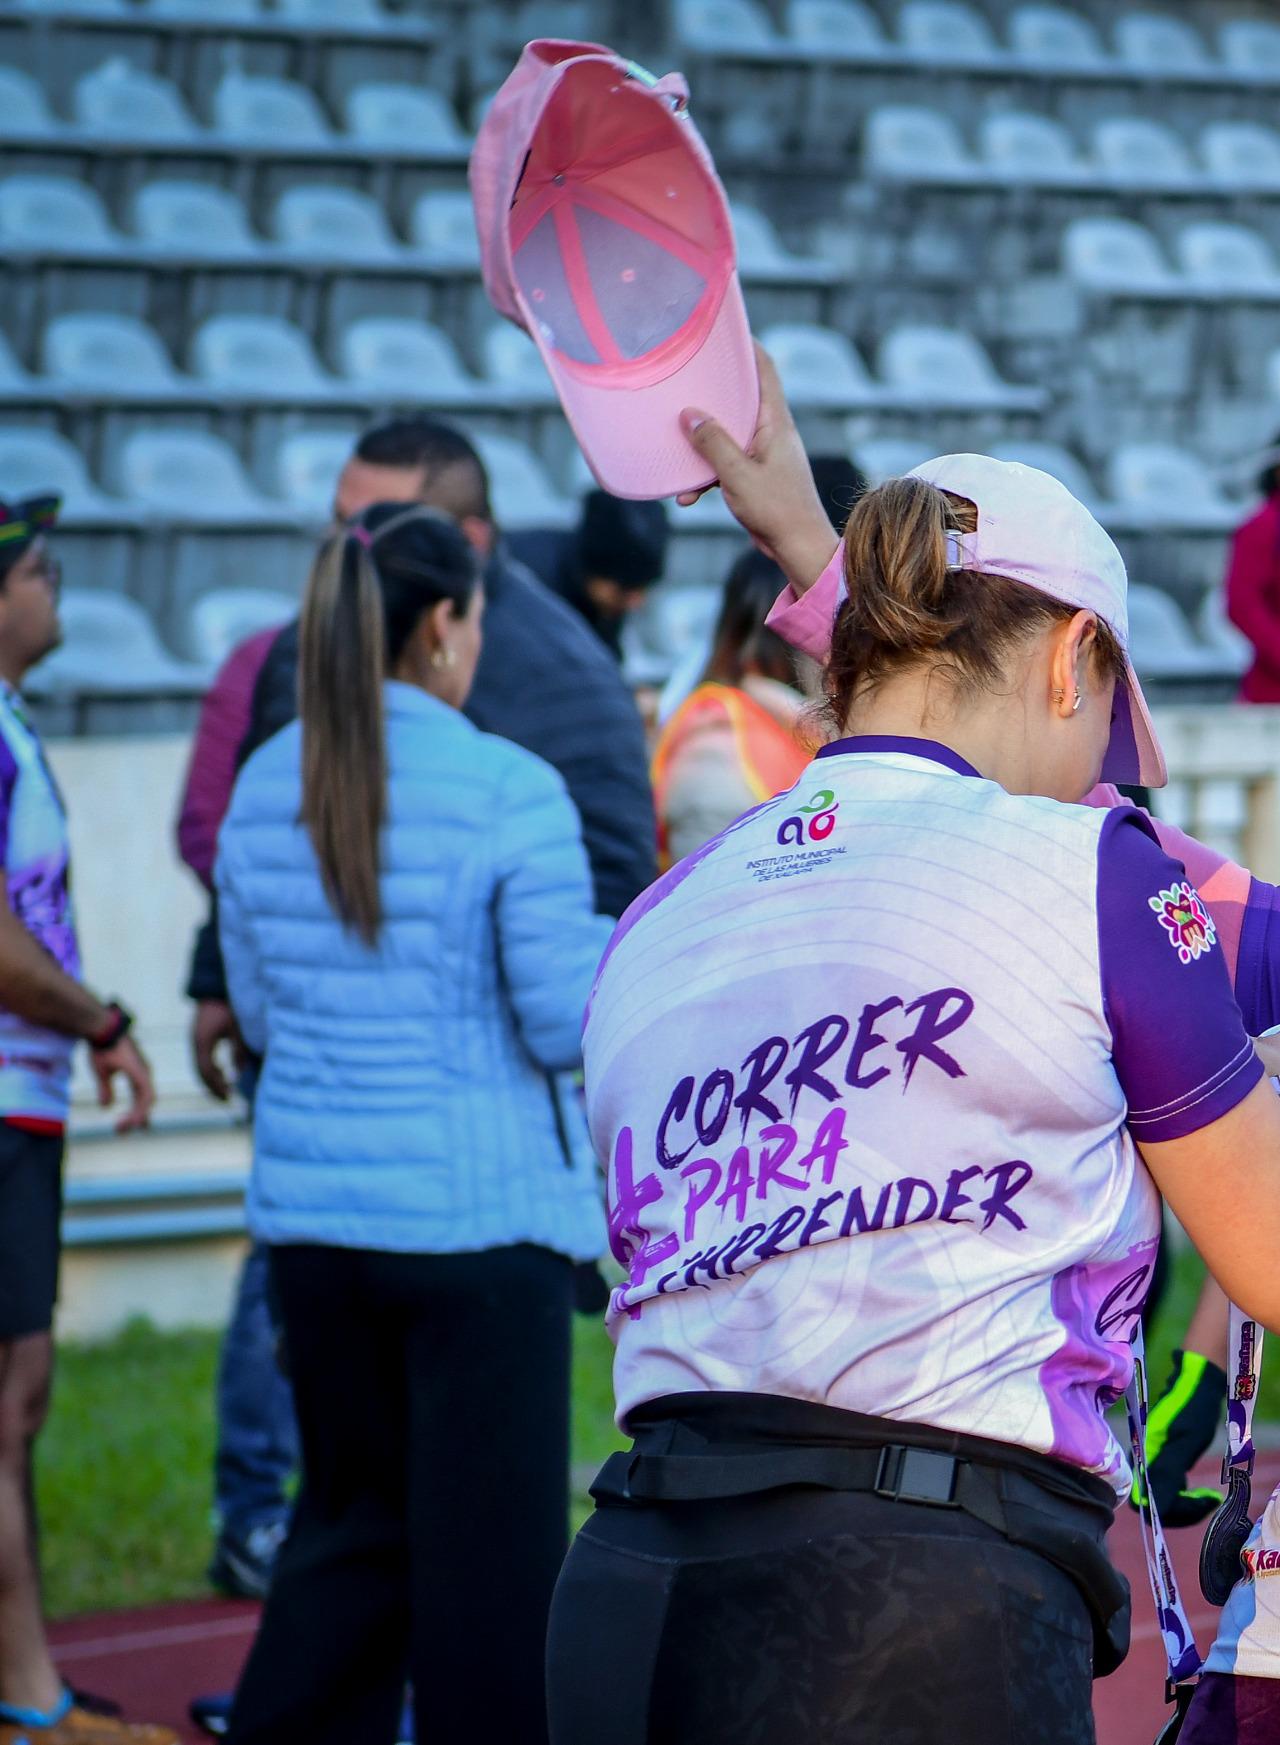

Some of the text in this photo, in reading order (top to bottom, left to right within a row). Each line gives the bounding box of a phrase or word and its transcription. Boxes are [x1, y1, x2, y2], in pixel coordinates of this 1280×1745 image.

[746, 847, 847, 869] INSTITUTO MUNICIPAL
[752, 868, 767, 878] DE
[656, 987, 974, 1170] CORRER
[679, 1106, 850, 1243] PARA
